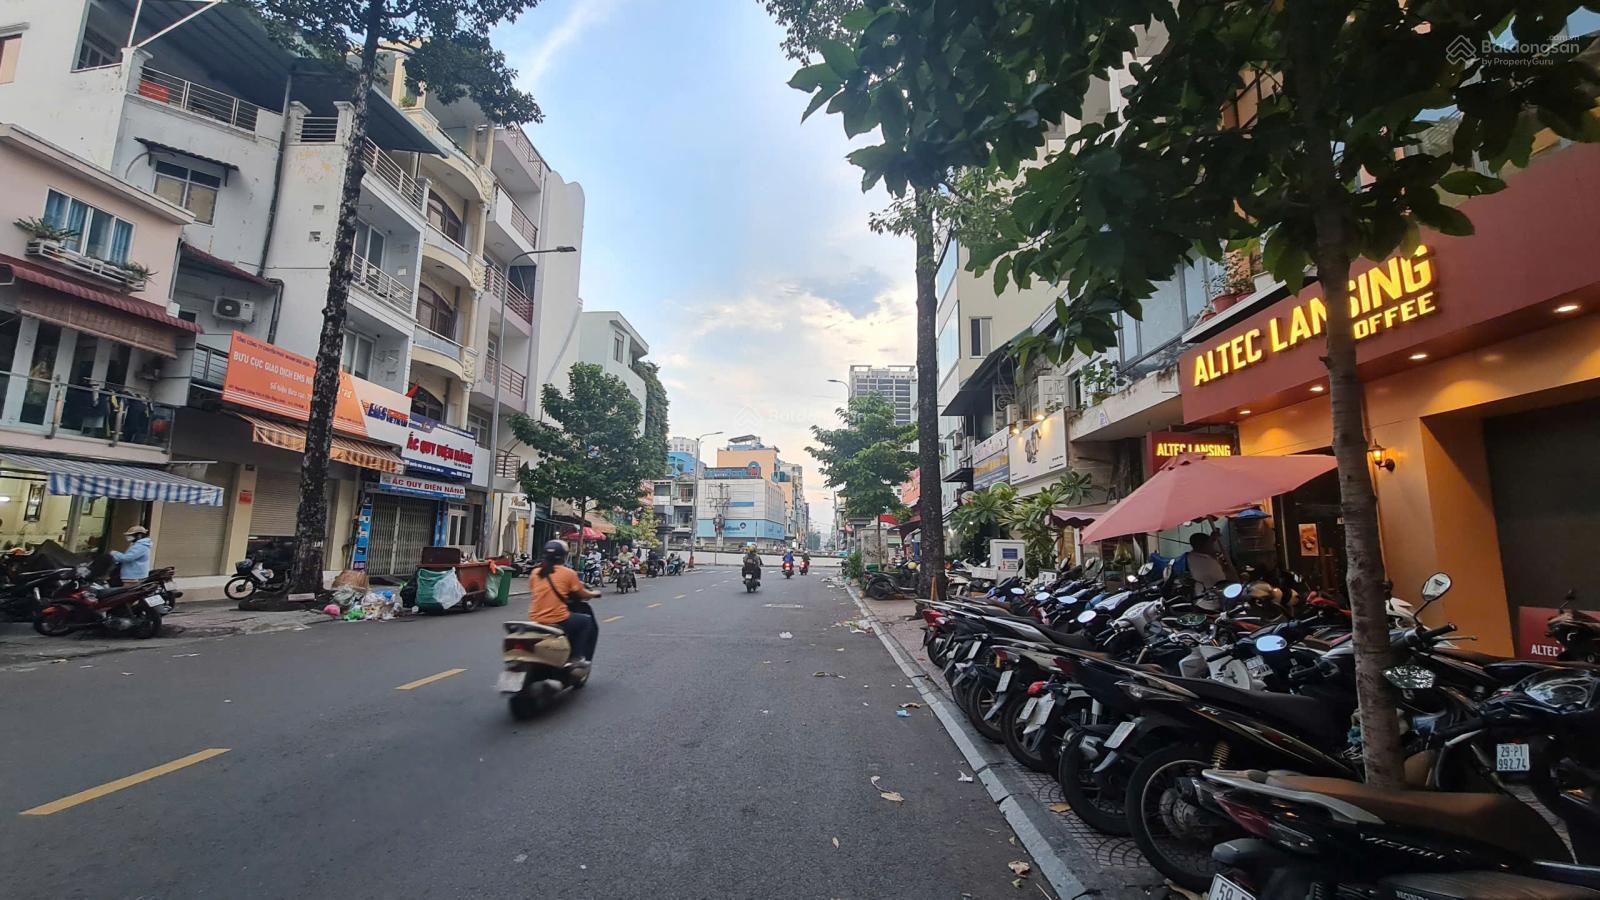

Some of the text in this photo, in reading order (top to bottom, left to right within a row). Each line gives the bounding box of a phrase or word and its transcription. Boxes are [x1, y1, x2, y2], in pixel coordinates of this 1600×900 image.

[1193, 328, 1263, 387] ALTEC
[264, 362, 279, 374] GIAO
[1156, 443, 1232, 457] ALTEC LANSING
[1531, 644, 1559, 657] ALTEC
